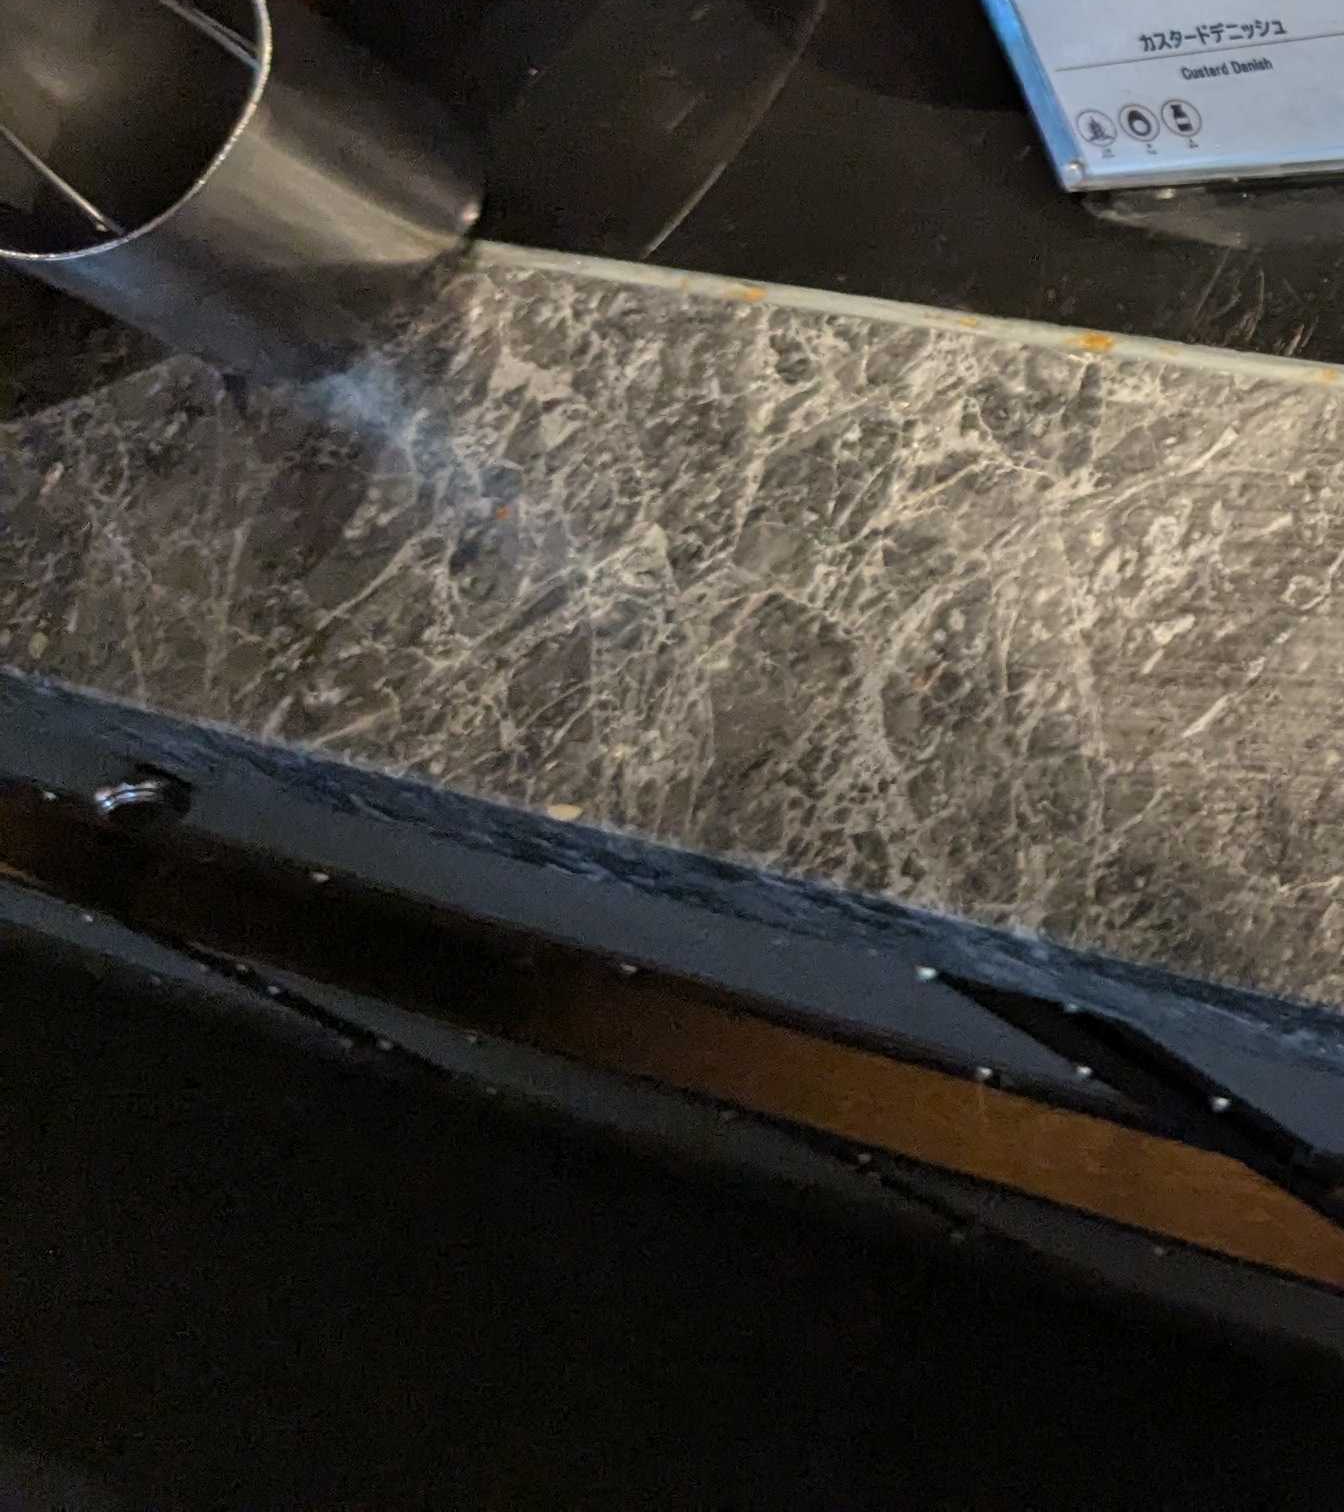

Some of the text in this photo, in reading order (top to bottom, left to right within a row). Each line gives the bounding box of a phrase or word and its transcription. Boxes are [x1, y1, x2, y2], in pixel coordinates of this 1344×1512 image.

[1139, 19, 1287, 52] カスタードデニッシュ
[1181, 57, 1273, 80] Custard Danish
